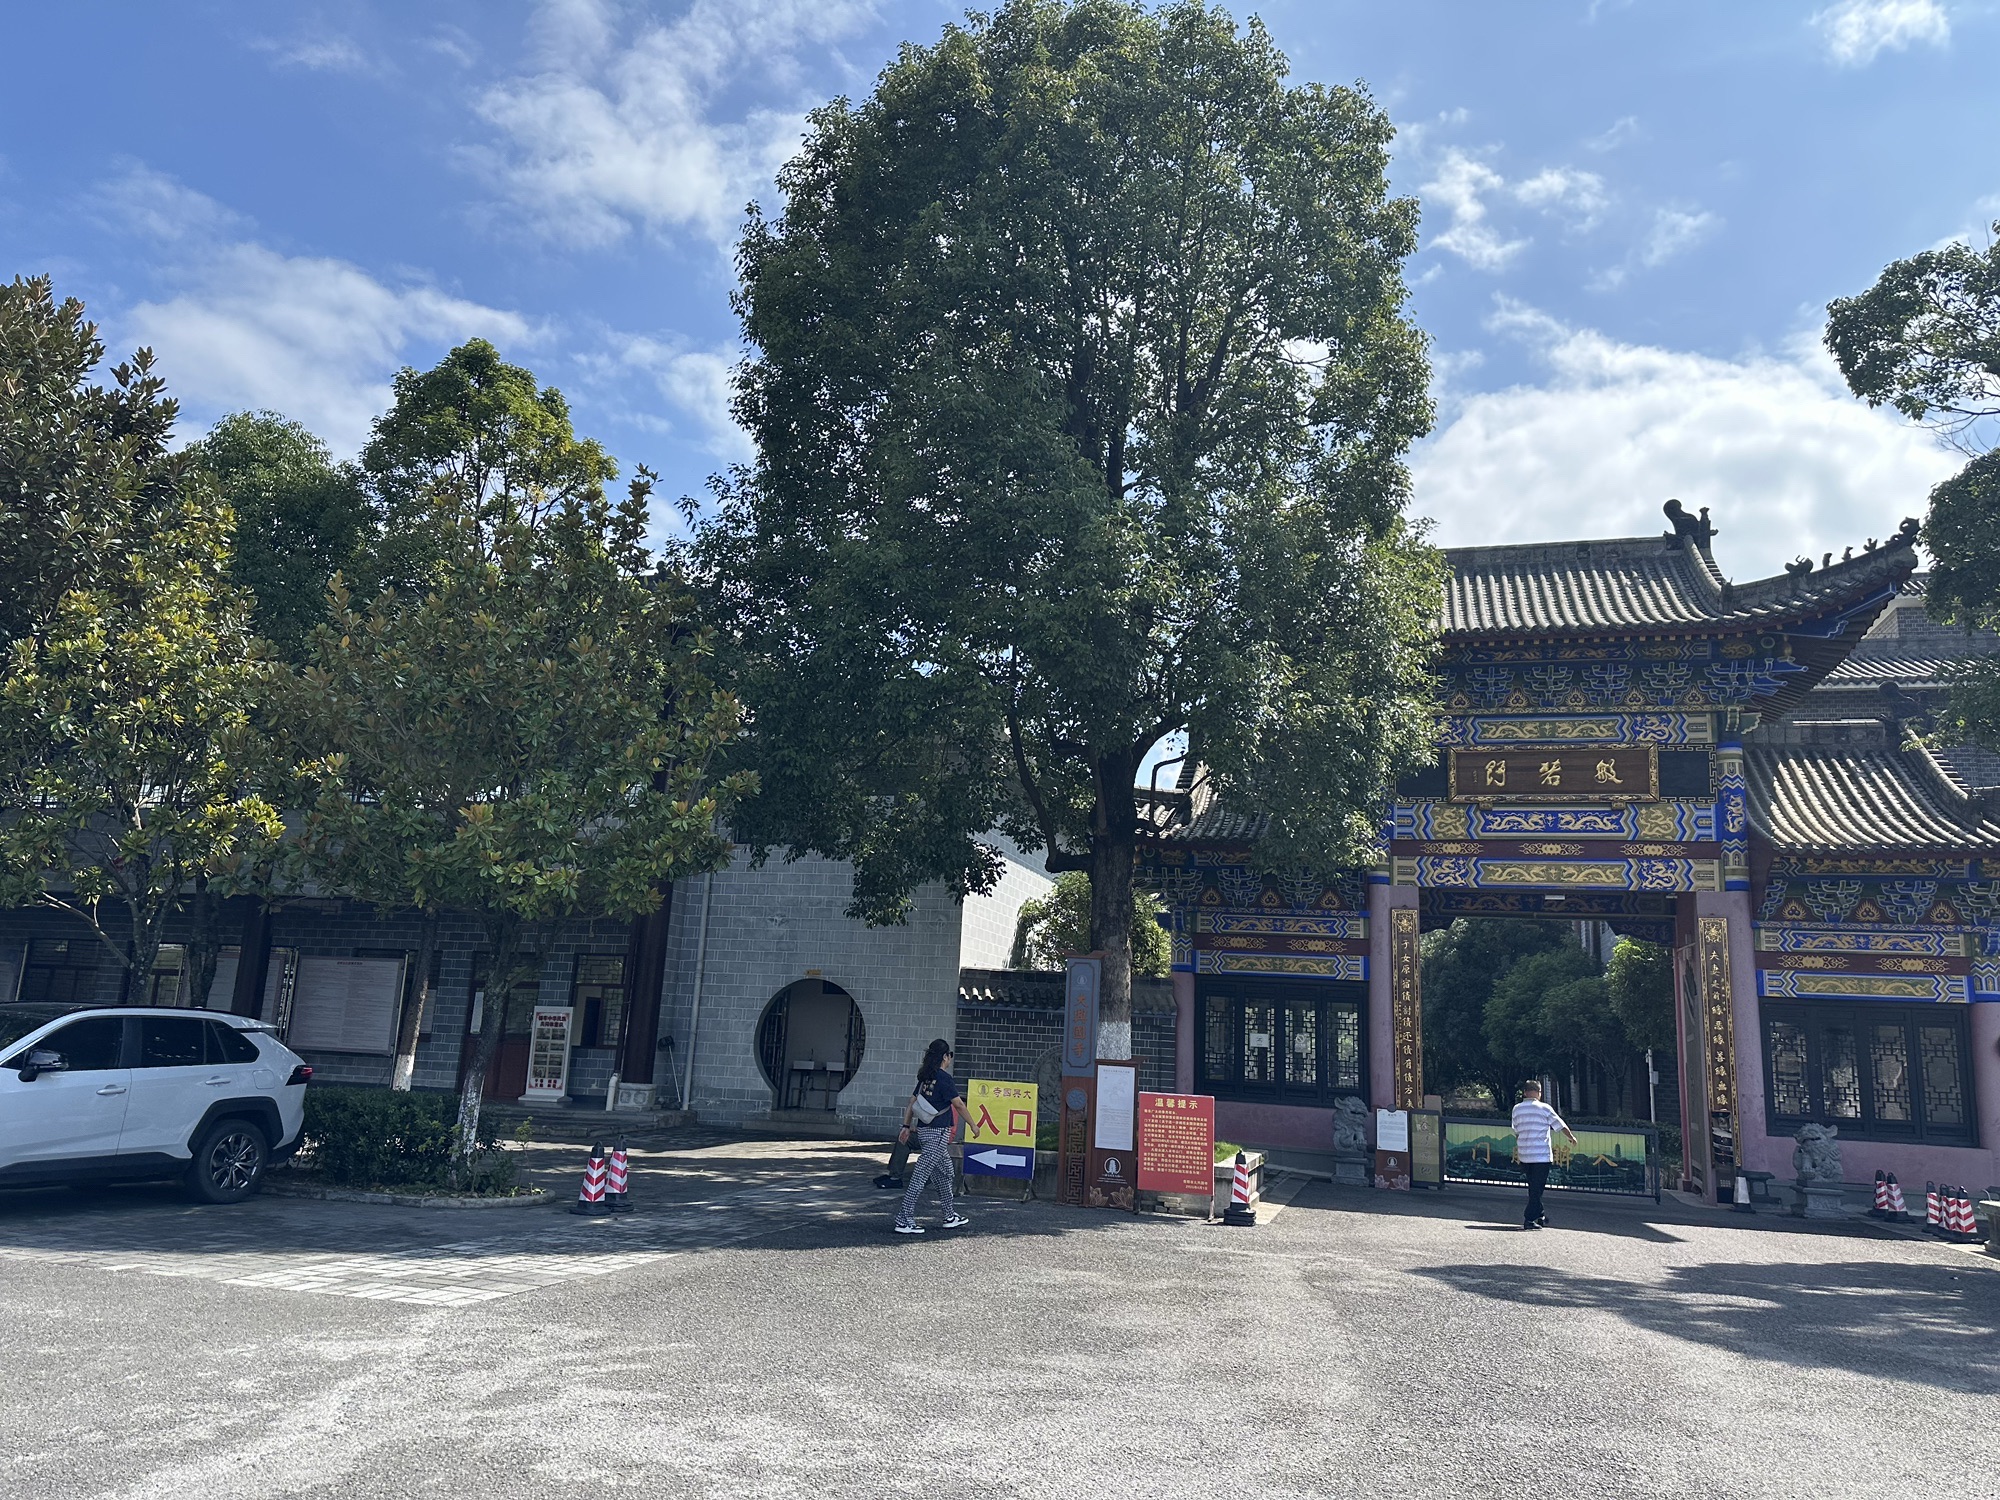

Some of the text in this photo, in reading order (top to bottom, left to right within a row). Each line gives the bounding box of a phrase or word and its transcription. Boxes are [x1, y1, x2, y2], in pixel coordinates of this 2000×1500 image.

[1155, 1098, 1198, 1109] 温馨提示
[976, 1103, 1032, 1137] 入口
